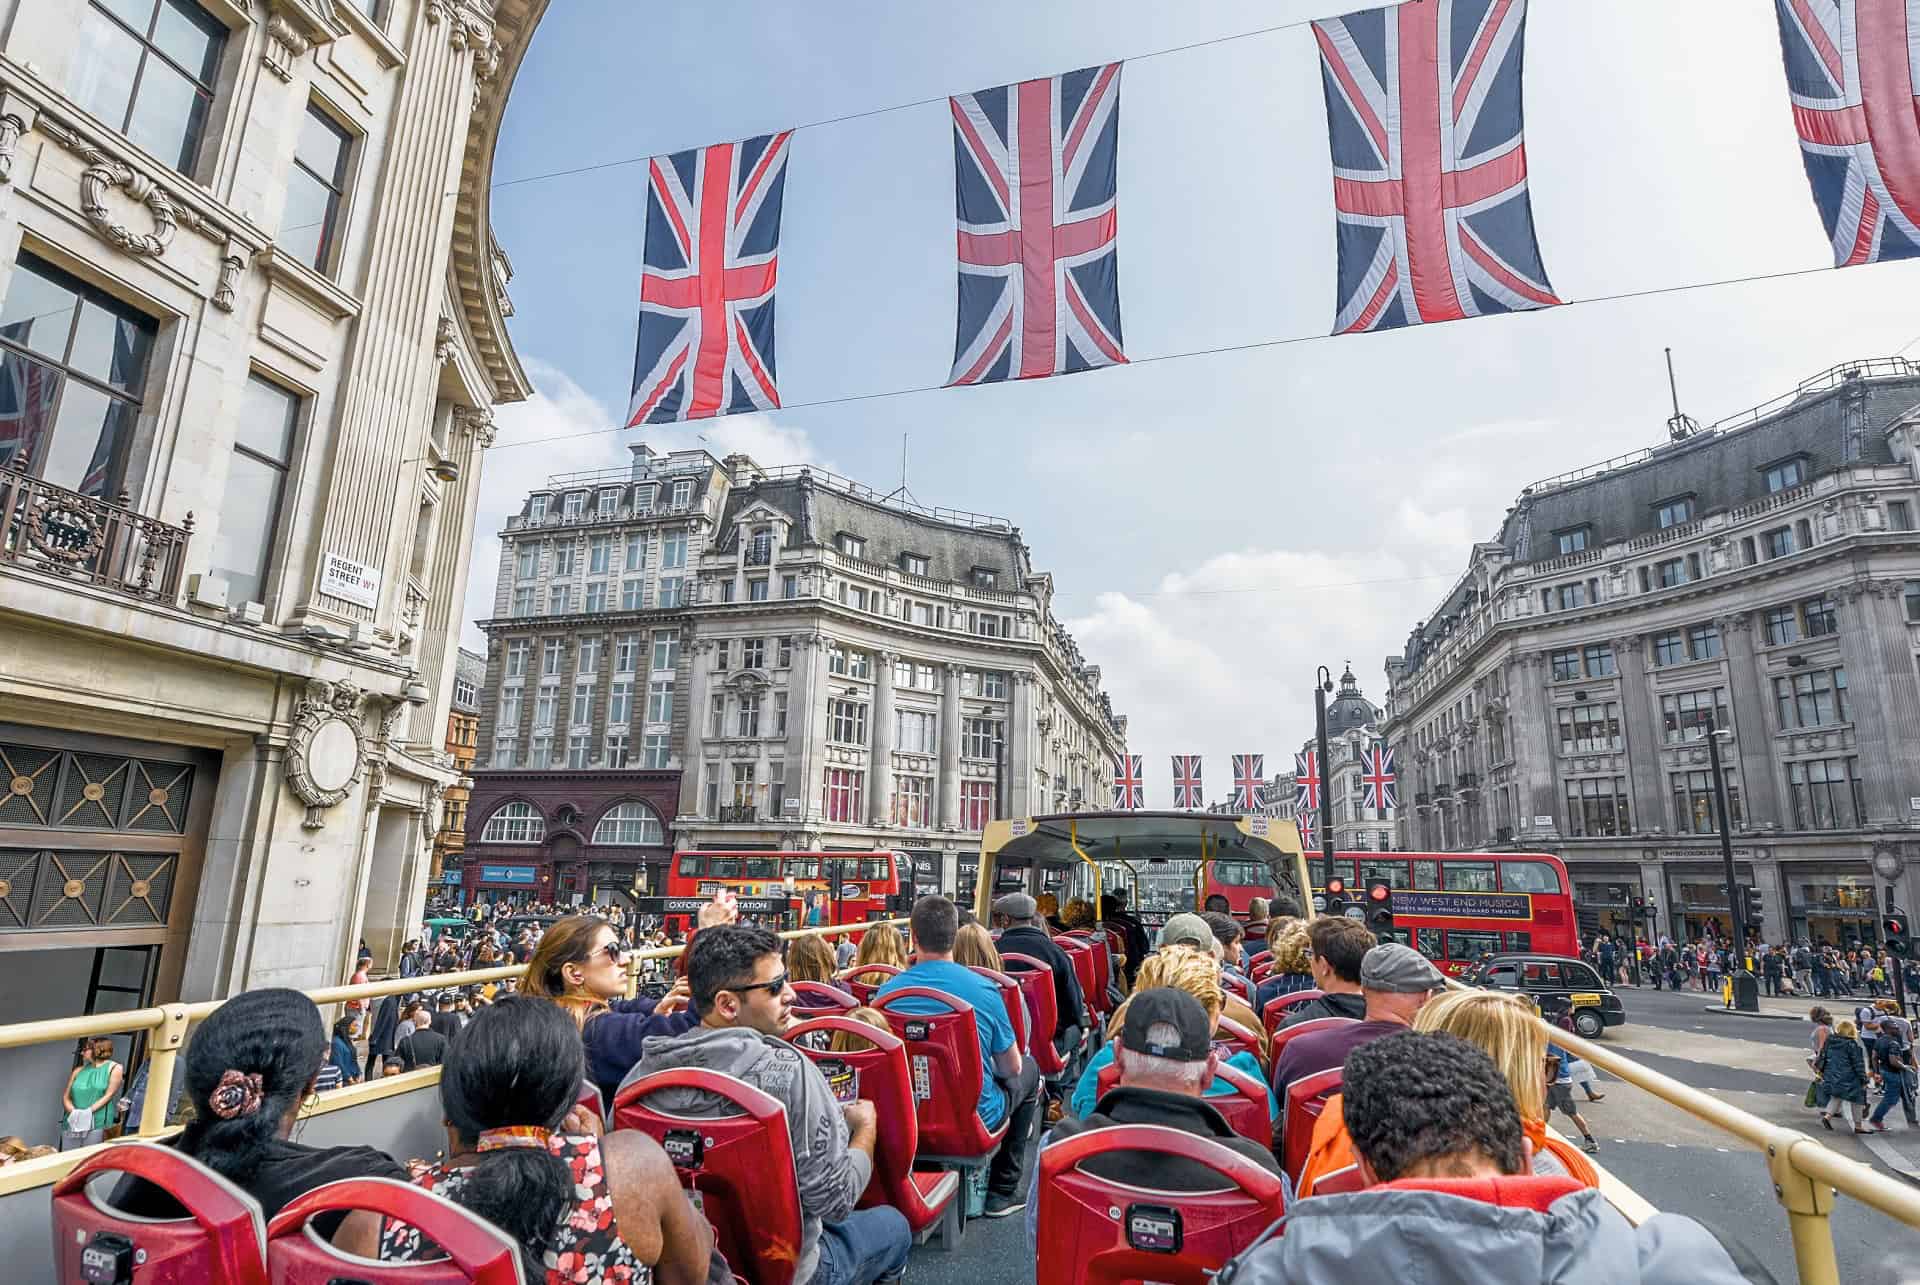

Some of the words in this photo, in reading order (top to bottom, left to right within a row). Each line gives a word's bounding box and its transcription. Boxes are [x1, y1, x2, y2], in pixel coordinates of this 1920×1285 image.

[330, 557, 364, 577] REGENT
[329, 567, 361, 585] STREET
[362, 580, 375, 591] W1
[668, 901, 706, 909] OXFORD
[1392, 896, 1418, 906] NEW
[1420, 897, 1449, 906] WEST
[1453, 898, 1476, 907] END
[1479, 899, 1527, 908] MUSICAL
